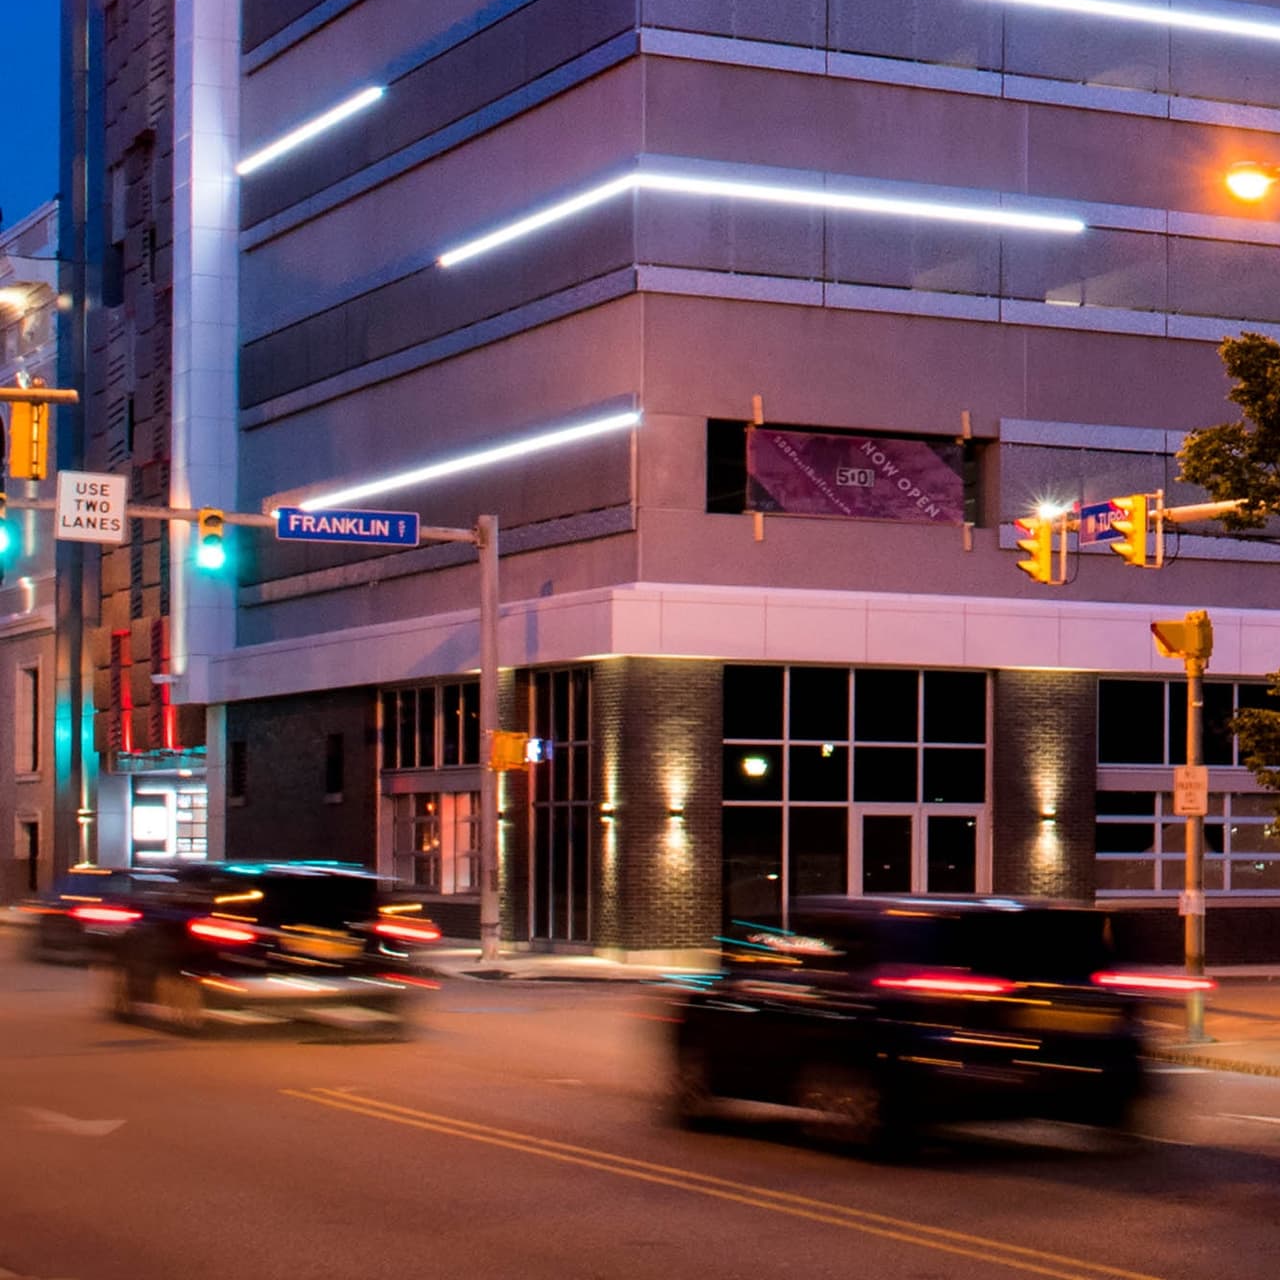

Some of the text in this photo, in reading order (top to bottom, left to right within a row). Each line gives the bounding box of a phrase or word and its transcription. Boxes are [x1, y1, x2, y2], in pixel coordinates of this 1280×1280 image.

[860, 441, 940, 517] NOW OPEN
[76, 482, 110, 496] USE
[73, 498, 111, 513] TWO
[62, 515, 121, 531] LANES
[289, 514, 390, 537] FRANKLIN
